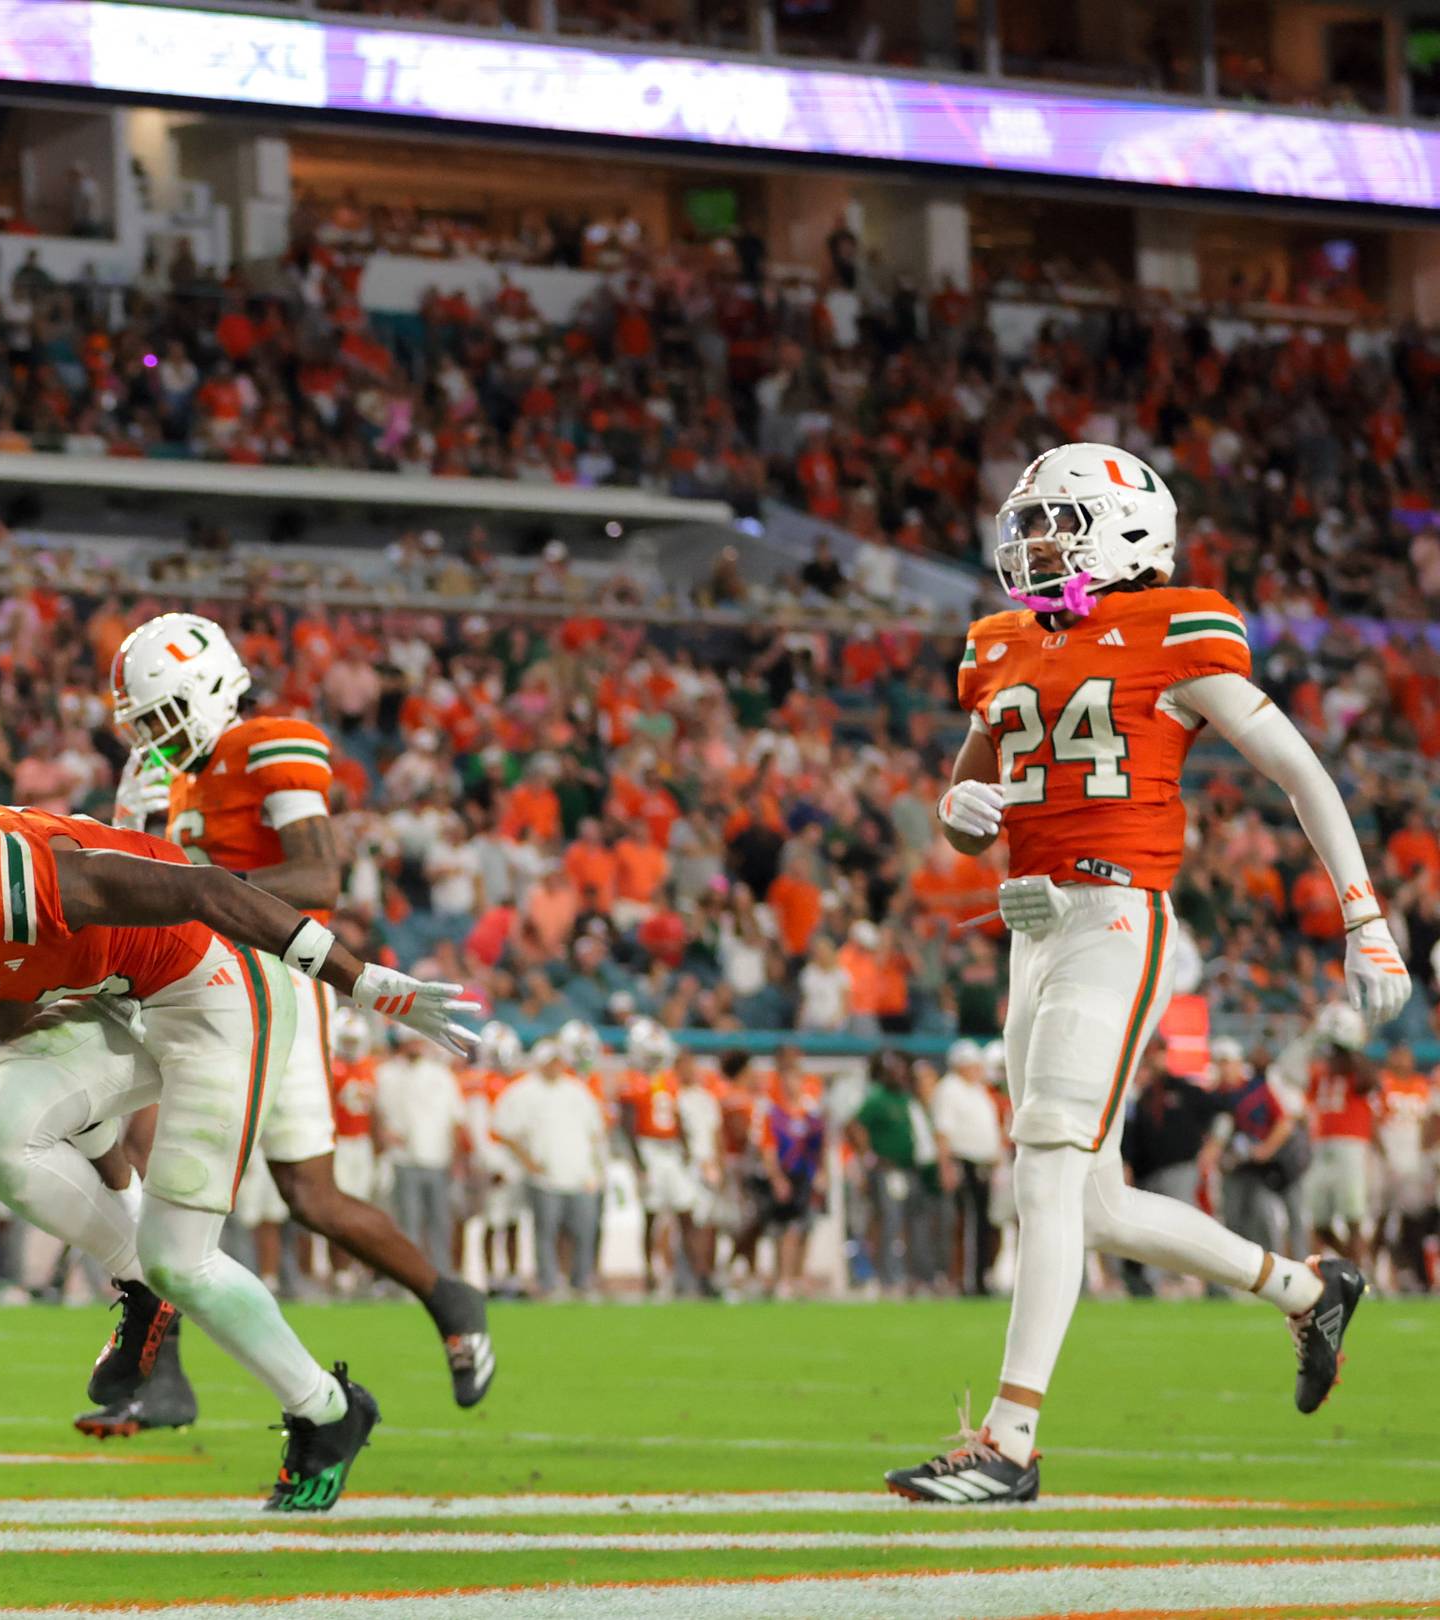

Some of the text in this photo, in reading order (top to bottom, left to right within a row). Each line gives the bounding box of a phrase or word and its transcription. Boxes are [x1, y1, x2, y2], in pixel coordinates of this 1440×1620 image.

[1103, 459, 1157, 493] U
[165, 628, 209, 662] U
[987, 677, 1131, 806] 24
